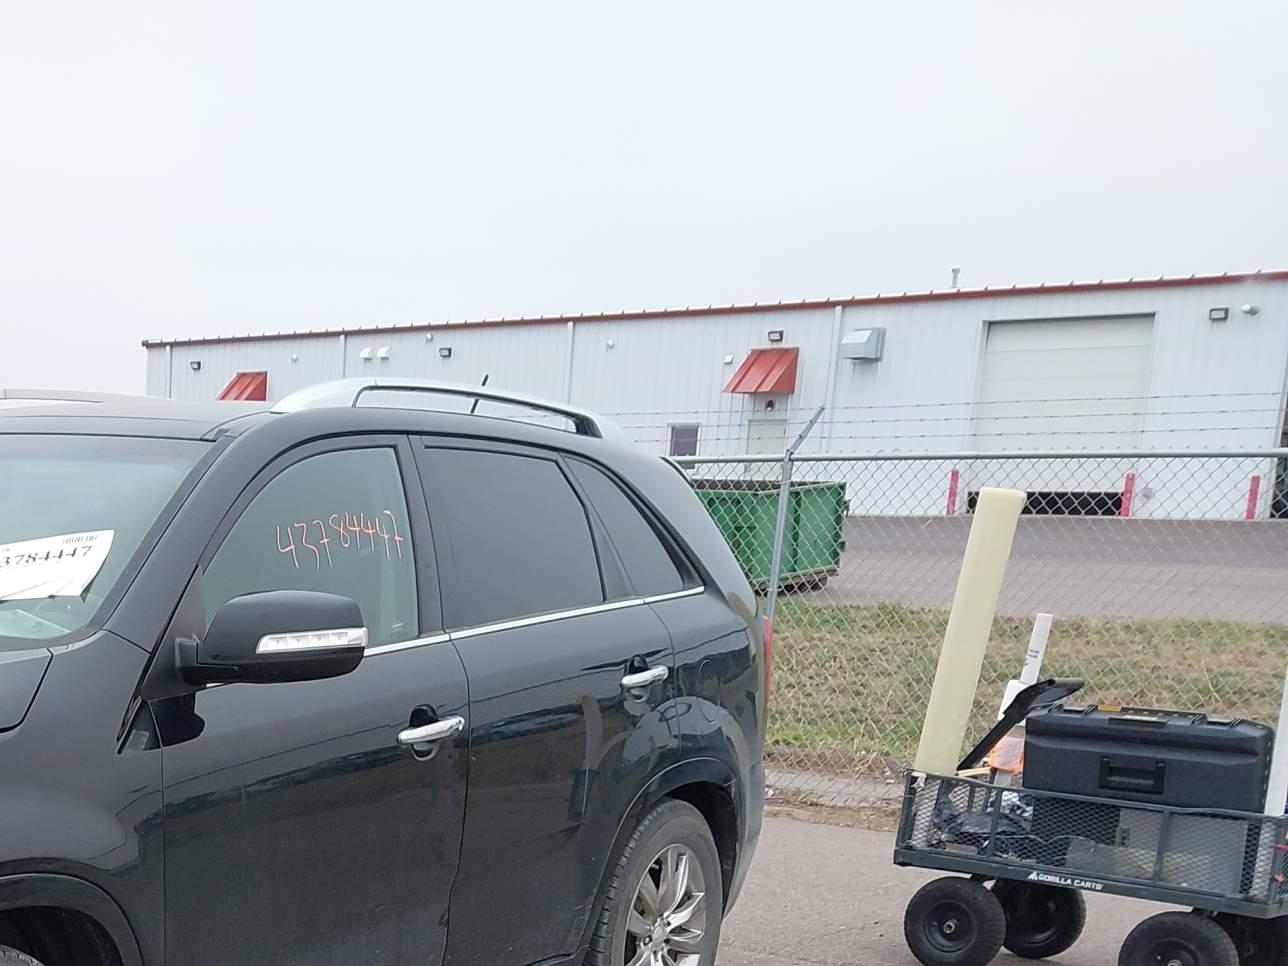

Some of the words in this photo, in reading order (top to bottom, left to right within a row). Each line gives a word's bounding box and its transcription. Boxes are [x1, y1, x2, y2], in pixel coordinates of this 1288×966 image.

[276, 509, 404, 572] 43784447
[1038, 873, 1072, 885] GORILLA
[1073, 879, 1103, 890] CARTS
